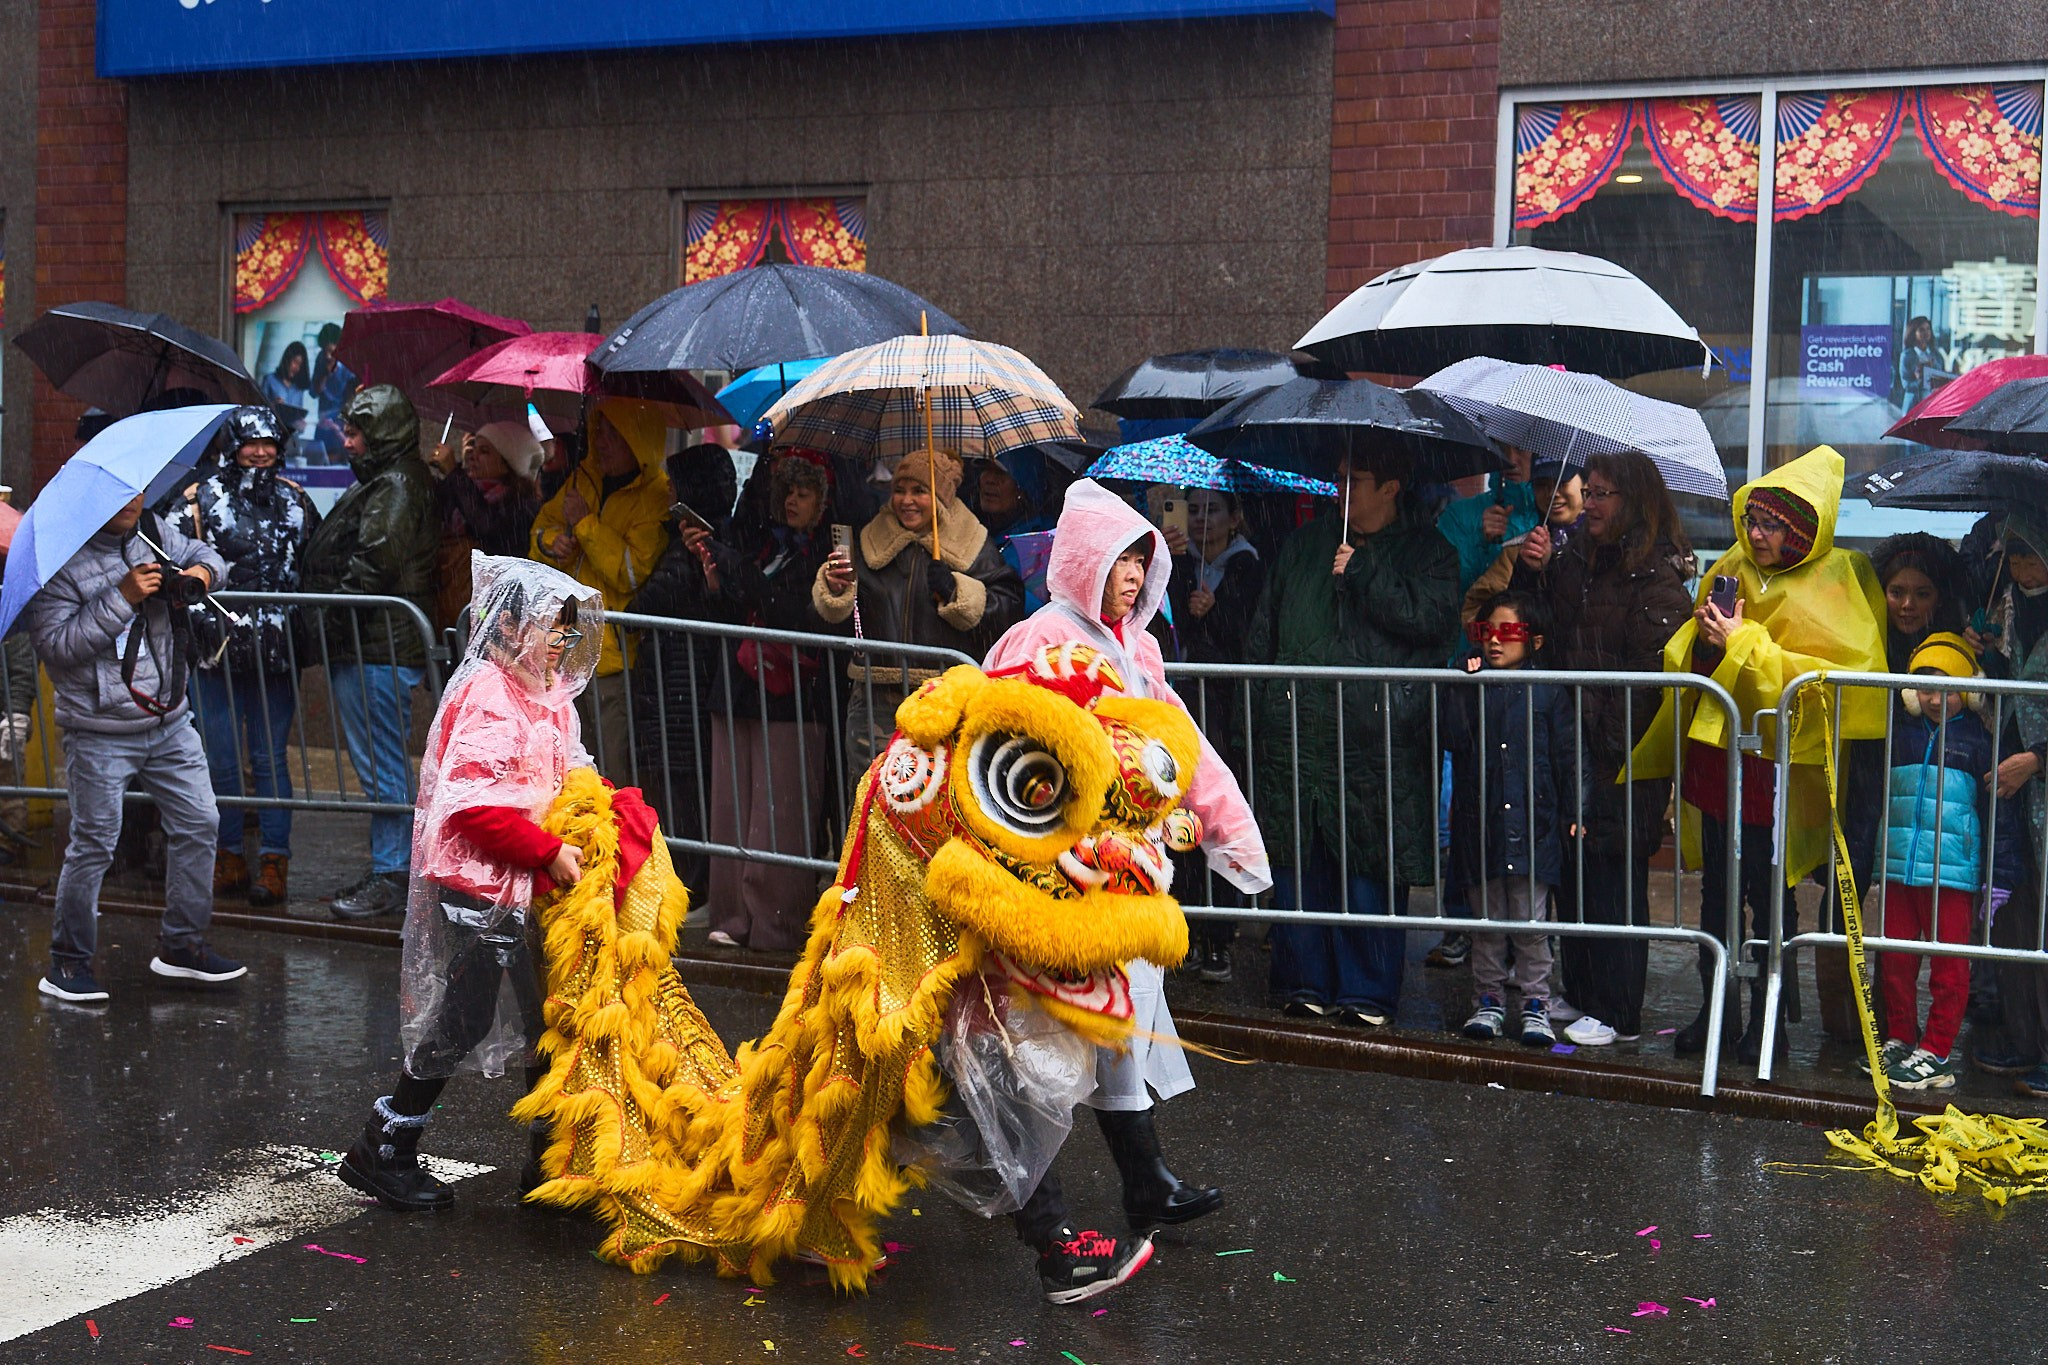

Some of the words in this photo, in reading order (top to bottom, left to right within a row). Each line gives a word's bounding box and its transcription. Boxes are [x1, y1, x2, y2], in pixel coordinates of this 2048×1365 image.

[1807, 335, 1823, 344] Get
[1825, 335, 1866, 344] rewarded
[1867, 335, 1887, 343] with
[1807, 344, 1883, 360] Complete
[1806, 359, 1844, 373] Cash
[1806, 374, 1873, 388] Rewards
